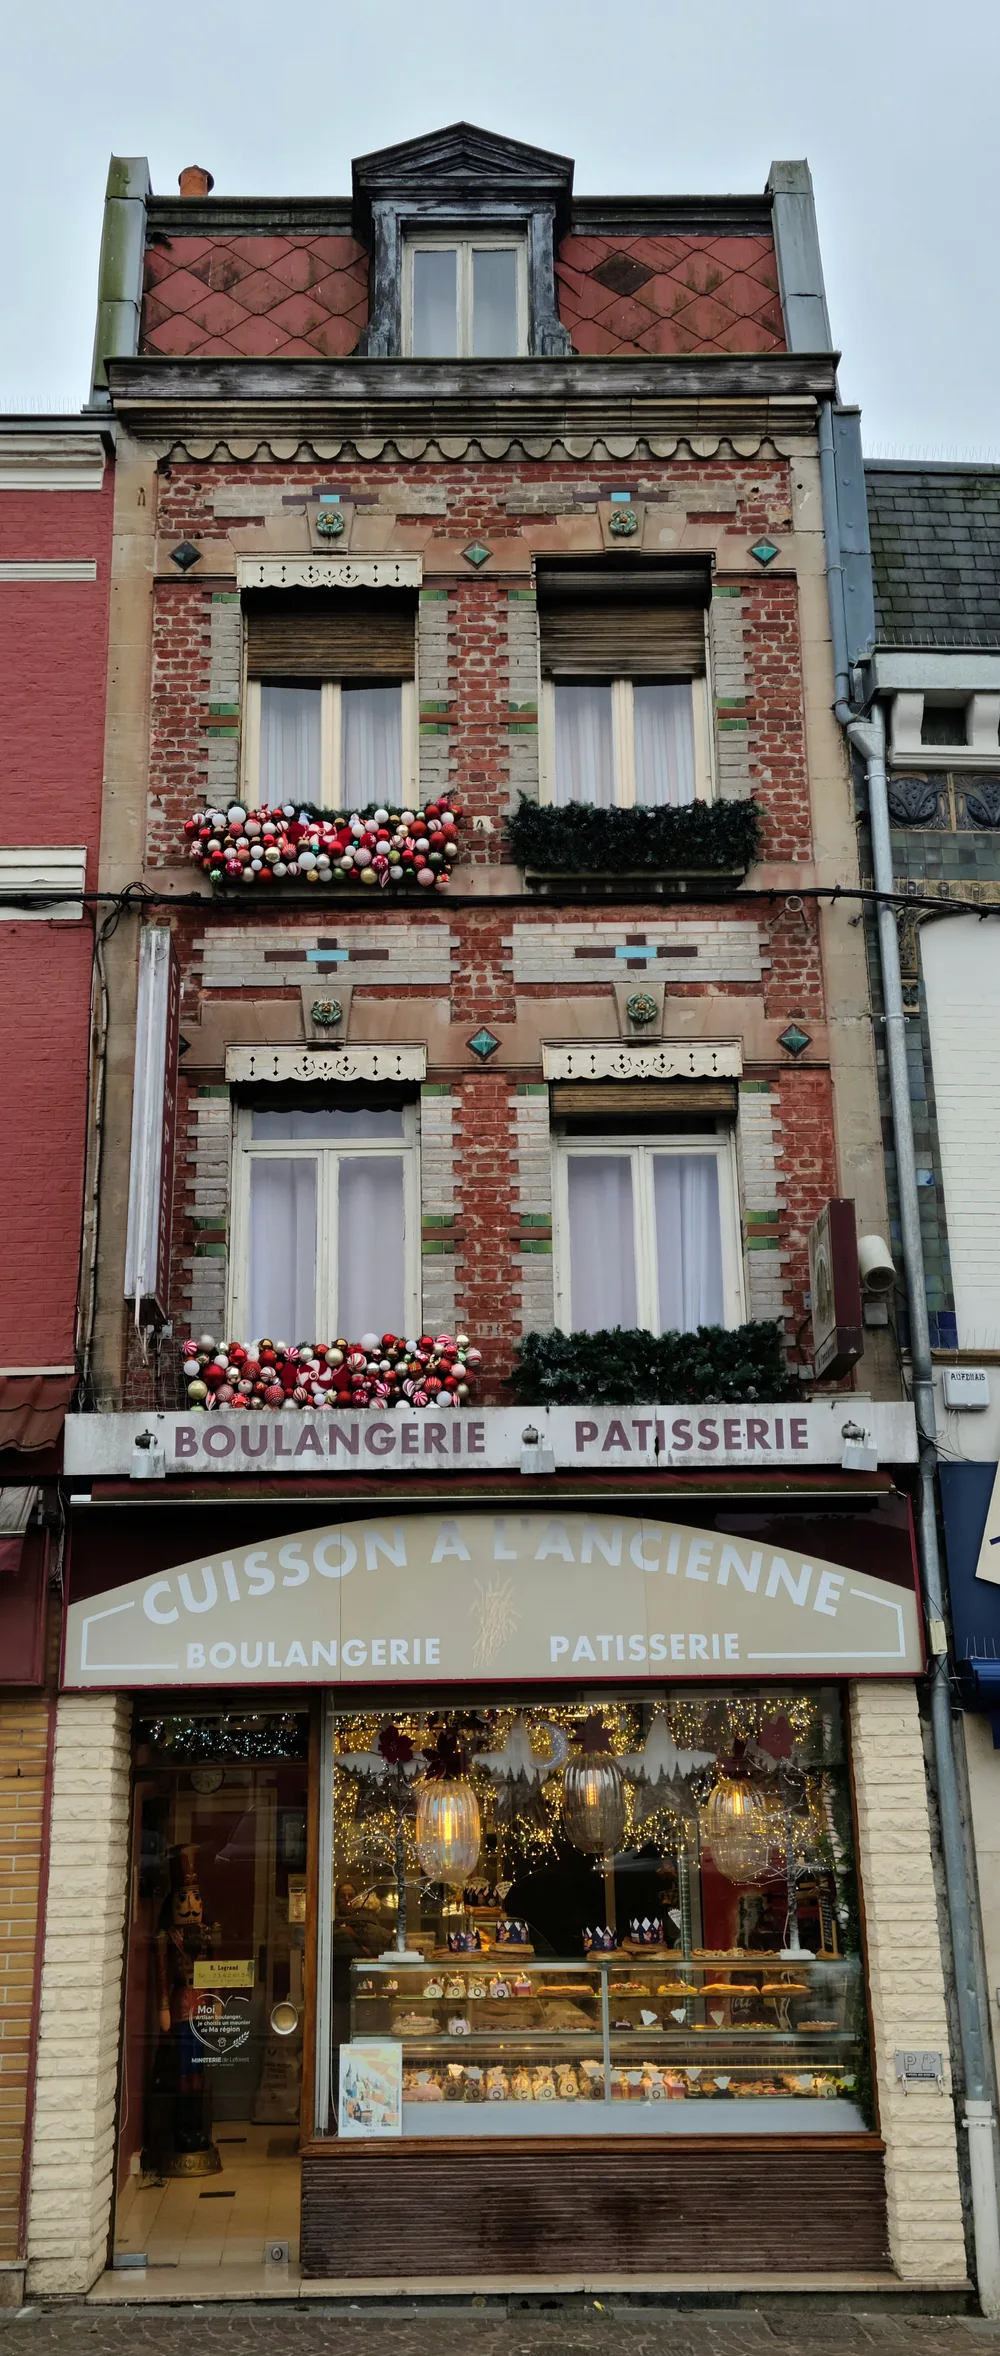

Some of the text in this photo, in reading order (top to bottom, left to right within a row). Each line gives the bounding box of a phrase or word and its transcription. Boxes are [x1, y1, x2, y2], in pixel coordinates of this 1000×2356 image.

[168, 962, 177, 1069] CUIT
[159, 1120, 170, 1298] PIERRE
[174, 1418, 810, 1458] BOULANGERIE PATISSERIE
[142, 1517, 846, 1625] CUISSON A L'ANCIENNE
[186, 1633, 740, 1669] BOULANGERIE PATISSERIE
[904, 2053, 916, 2071] P
